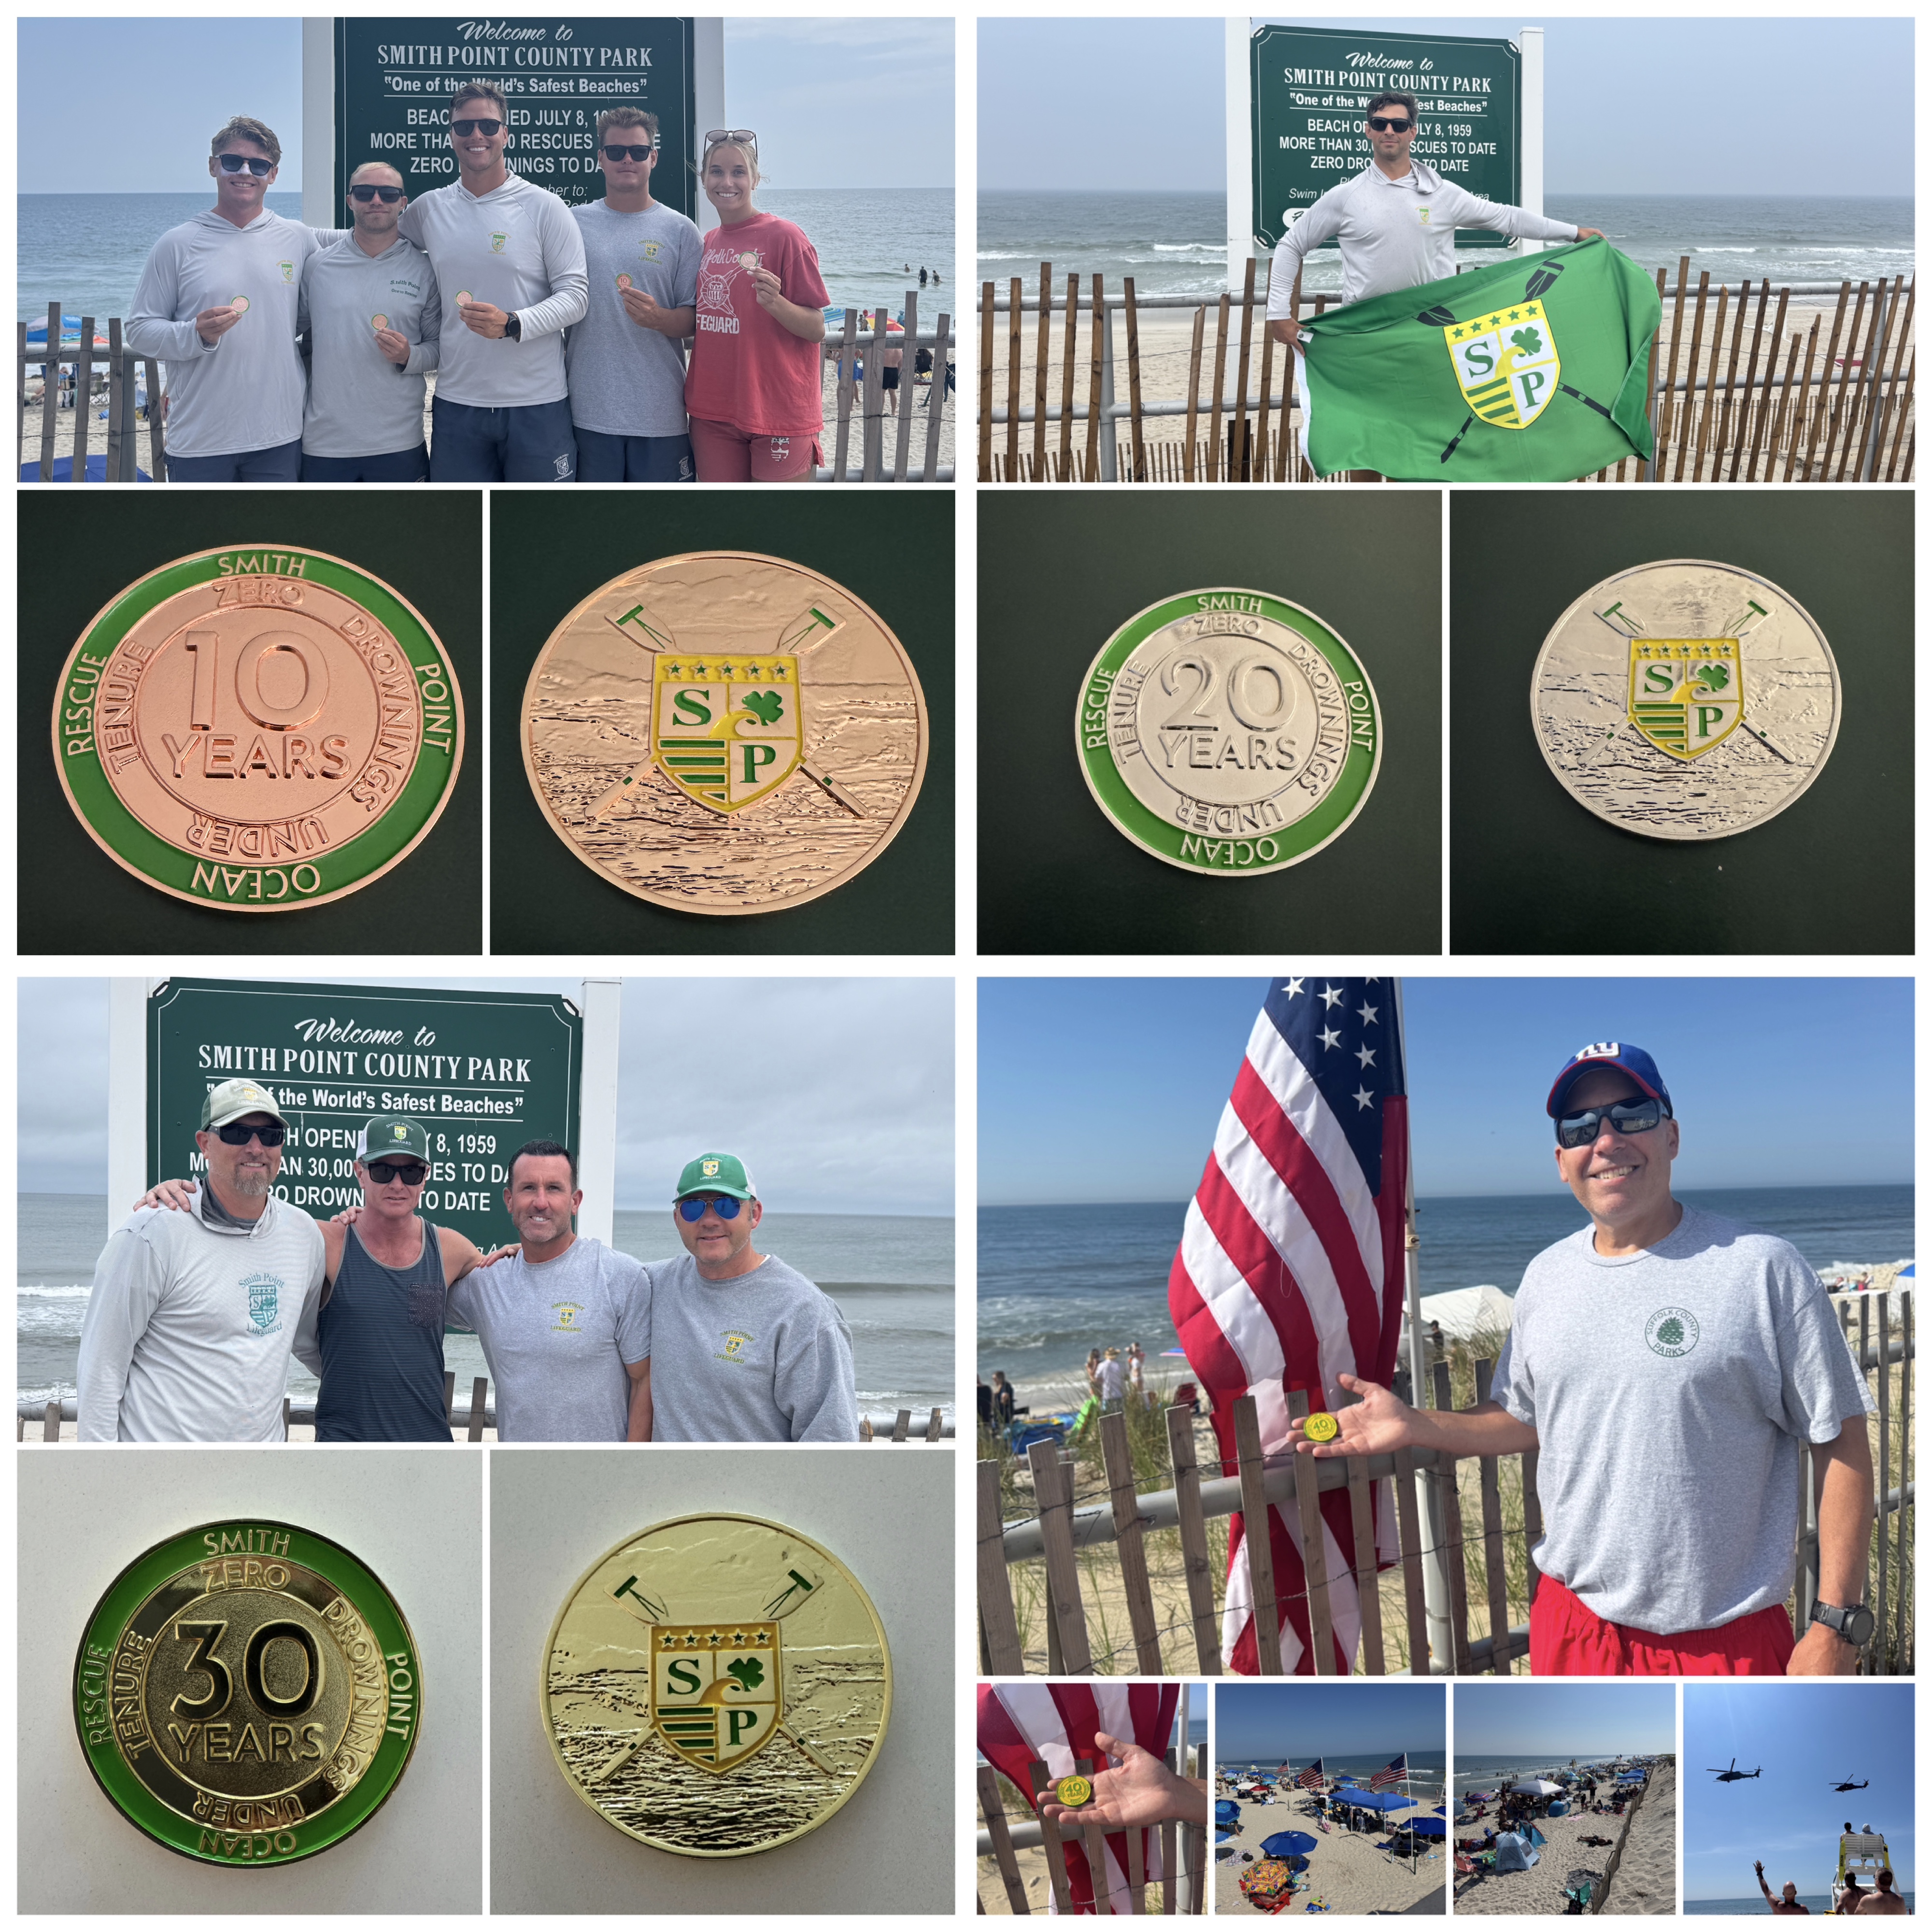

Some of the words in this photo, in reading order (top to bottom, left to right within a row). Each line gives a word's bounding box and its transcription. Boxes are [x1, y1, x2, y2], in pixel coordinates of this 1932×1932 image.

[456, 20, 547, 41] Welcome
[555, 24, 573, 41] to
[378, 44, 442, 65] SMITH
[448, 46, 510, 66] POINT
[515, 47, 595, 67] COUNTY
[600, 48, 653, 67] PARK
[1345, 51, 1414, 70] Welcome
[1420, 57, 1434, 71] to
[426, 77, 440, 92] of
[444, 77, 469, 92] the
[529, 78, 575, 93] Safest
[1284, 68, 1335, 85] SMITH
[1338, 71, 1386, 88] POINT
[1390, 73, 1449, 91] COUNTY
[1453, 77, 1492, 93] PARK
[1322, 95, 1334, 106] of
[1336, 95, 1355, 107] the
[407, 109, 450, 125] BEAC
[535, 110, 572, 126] JULY
[576, 110, 588, 128] 8,
[1308, 119, 1350, 132] BEACH
[1435, 123, 1444, 138] 8,
[1448, 124, 1472, 137] 1959
[370, 132, 417, 149] MORE
[422, 133, 453, 149] THA
[521, 133, 593, 150] RESCUES
[1279, 136, 1316, 150] MORE
[1319, 138, 1352, 151] THAN
[1409, 141, 1448, 154] SCUES
[1450, 142, 1465, 154] TO
[1469, 142, 1497, 155] DATE
[410, 157, 454, 173] ZERO
[559, 157, 580, 173] TO
[584, 157, 605, 173] DA
[1310, 156, 1344, 169] ZERO
[1422, 159, 1437, 171] TO
[1441, 159, 1469, 171] DATE
[572, 184, 588, 196] to:
[1289, 188, 1317, 199] Swim
[700, 248, 725, 270] ffolk
[696, 314, 739, 334] FEGUARD
[1464, 341, 1494, 378] S
[1517, 371, 1545, 409] P
[217, 554, 307, 578] SMITH
[214, 582, 306, 609] ZERO
[1197, 596, 1263, 614] SMITH
[1193, 614, 1262, 636] ZERO
[185, 630, 329, 731] 10
[1160, 654, 1298, 732] 20
[1644, 664, 1674, 694] S
[65, 653, 109, 757] RESCUE
[102, 639, 154, 774] TENURE
[340, 613, 414, 812] DROWNINGS
[415, 662, 452, 755] POINT
[672, 689, 711, 726] S
[1085, 667, 1117, 750] RESCUE
[1113, 660, 1151, 765] TENURE
[1288, 643, 1344, 796] DROWNINGS
[1345, 680, 1373, 752] POINT
[1694, 706, 1723, 738] P
[161, 733, 352, 780] YEARS
[739, 744, 777, 784] P
[1159, 733, 1300, 770] YEARS
[1176, 795, 1284, 833] UNDER
[185, 814, 330, 859] UNDER
[1179, 835, 1279, 866] OCEAN
[190, 861, 321, 899] OCEAN
[294, 1017, 404, 1045] Welcome
[414, 1025, 436, 1047] to
[199, 1044, 277, 1071] SMITH
[283, 1048, 358, 1075] POINT
[364, 1052, 462, 1080] COUNTY
[467, 1056, 532, 1082] PARK
[279, 1088, 307, 1106] the
[312, 1088, 376, 1109] World's
[381, 1092, 436, 1112] Safest
[305, 1128, 356, 1149] OPEN
[436, 1133, 451, 1156] 8,
[457, 1134, 497, 1154] 1959
[277, 1156, 302, 1176] AN
[308, 1157, 357, 1180] 30,00
[462, 1163, 486, 1183] TO
[295, 1185, 364, 1207] DROWN
[419, 1190, 439, 1210] TO
[444, 1191, 491, 1211] DATE
[238, 1272, 261, 1289] Smith
[264, 1272, 285, 1288] Point
[569, 1302, 585, 1311] POINT
[246, 1320, 282, 1337] Lifeguard
[739, 1331, 754, 1342] POINT
[1647, 1309, 1673, 1335] SUFFOLK
[1676, 1310, 1697, 1338] COUNTY
[714, 1353, 745, 1364] LIFEGUARD
[1653, 1343, 1685, 1357] PARKS
[203, 1529, 291, 1556] SMITH
[199, 1560, 291, 1593] ZERO
[169, 1619, 327, 1722] 30
[668, 1659, 701, 1695] S
[83, 1645, 112, 1746] RESCUE
[114, 1631, 152, 1761] TENURE
[320, 1596, 381, 1791] DROWNINGS
[386, 1652, 414, 1741] POINT
[726, 1709, 758, 1747] P
[168, 1723, 325, 1764] YEARS
[1065, 1782, 1082, 1792] 40
[193, 1791, 305, 1827] UNDER
[199, 1831, 297, 1859] OCEAN
